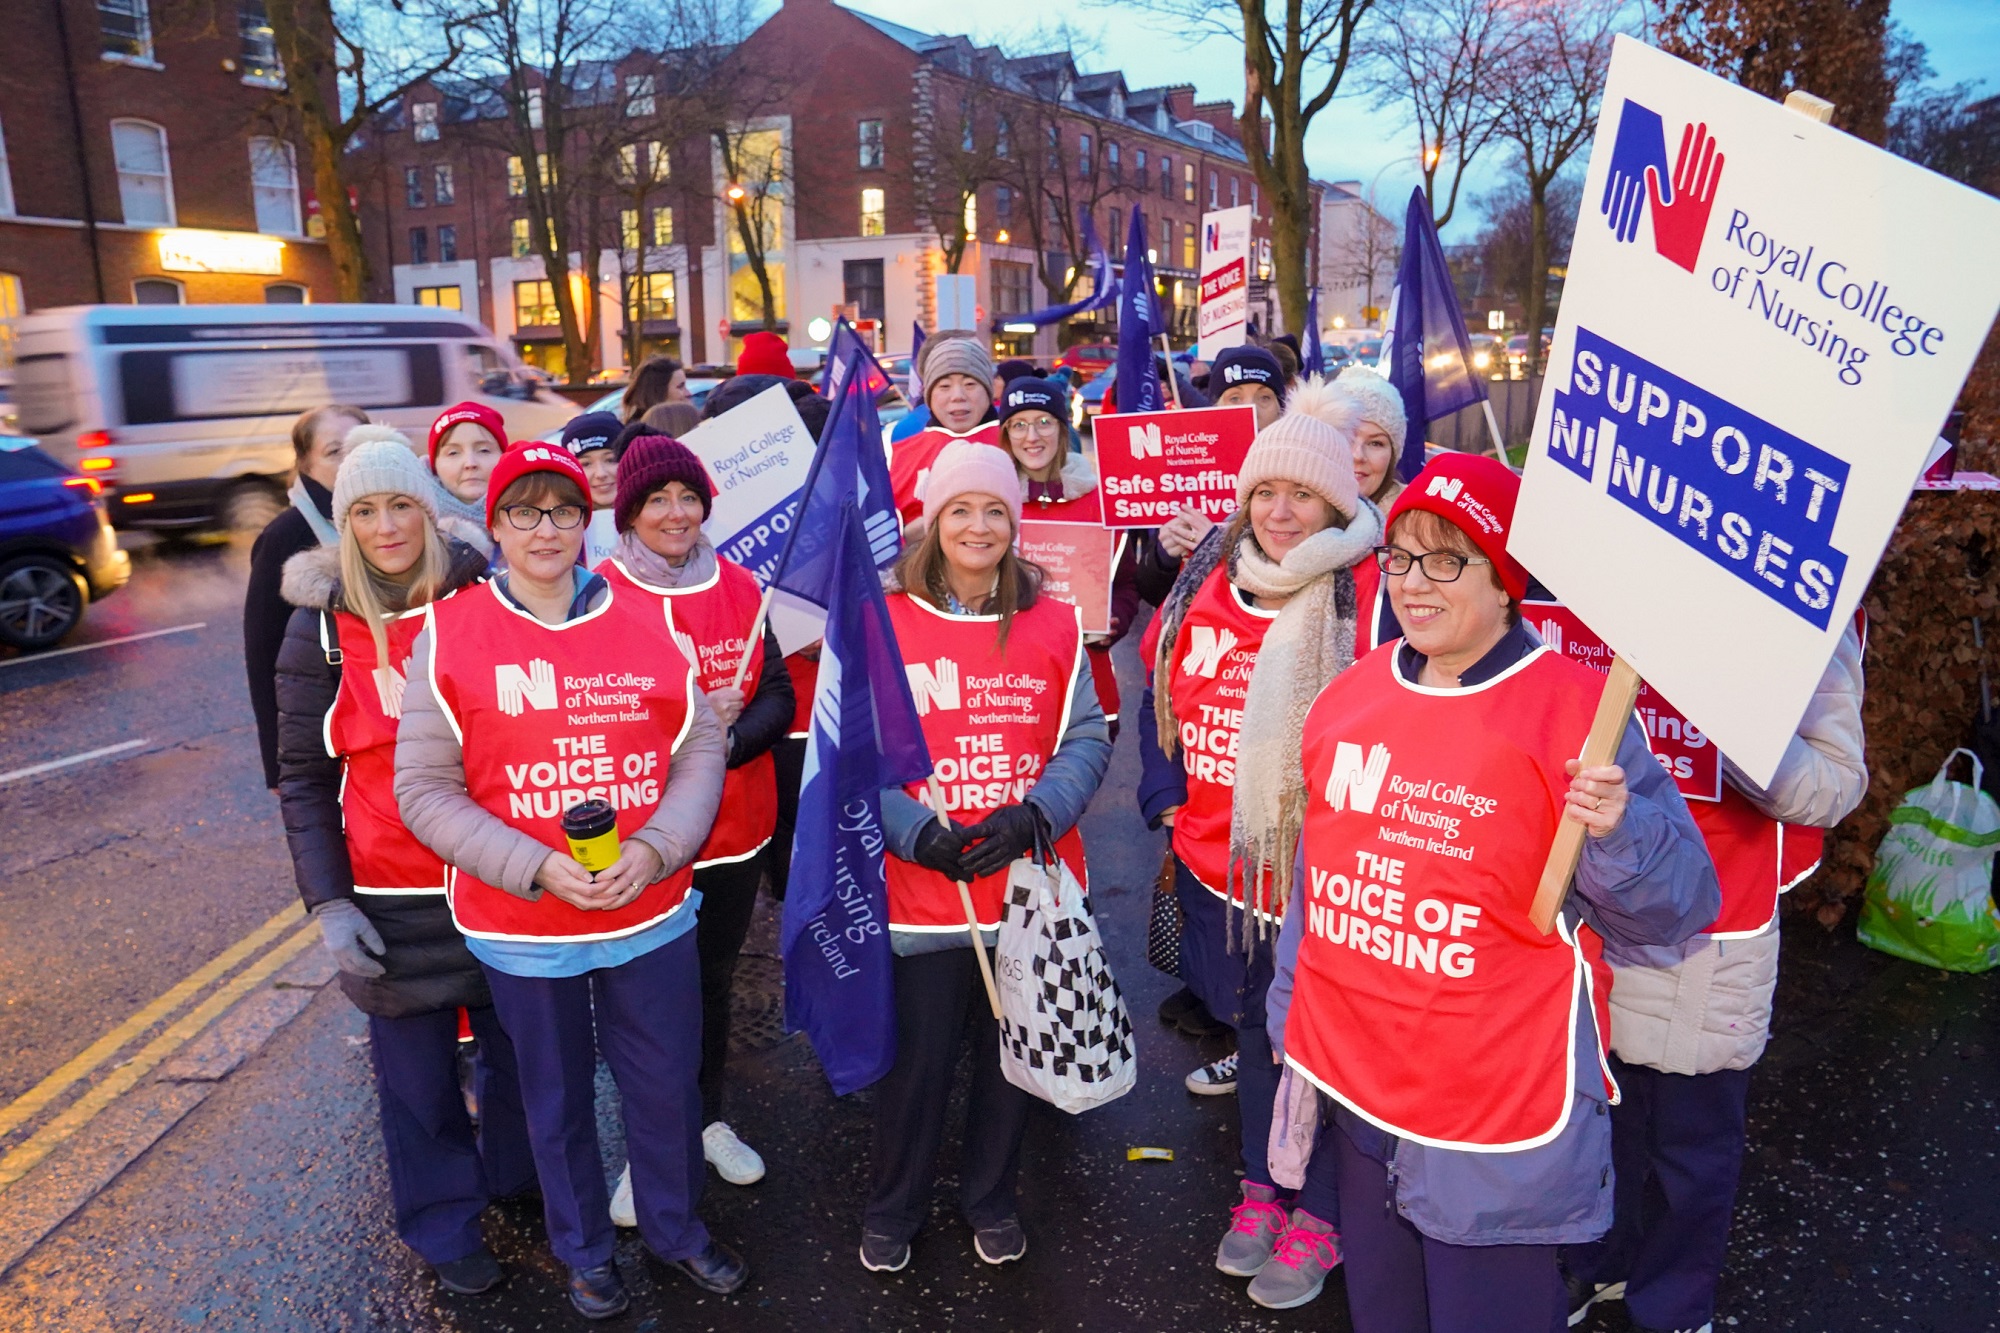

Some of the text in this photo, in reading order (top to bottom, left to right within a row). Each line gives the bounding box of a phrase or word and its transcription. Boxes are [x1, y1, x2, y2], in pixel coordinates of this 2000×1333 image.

[1725, 209, 1945, 357] Royal College
[1712, 264, 1870, 386] of Nursing
[1164, 432, 1219, 447] Royal College
[1573, 349, 1841, 523] SUPPORT
[714, 424, 795, 475] Royal College
[1165, 446, 1208, 457] of Nursing
[724, 450, 789, 490] of Nursing
[1105, 470, 1239, 495] Safe Staffin
[1115, 500, 1181, 518] Saves
[1462, 492, 1485, 512] Royal
[1549, 408, 1835, 611] NI NURSES
[1227, 648, 1257, 665] Roya
[1569, 641, 1604, 659] Royal
[564, 673, 656, 693] Royal College
[966, 673, 1047, 694] Royal College
[1222, 666, 1237, 681] of
[565, 691, 641, 710] of Nursing
[967, 693, 1033, 712] of Nursing
[568, 708, 649, 726] Northern Ireland
[969, 713, 1012, 725] Northern
[1199, 704, 1244, 729] THE
[553, 735, 606, 757] THE
[954, 733, 1004, 754] THE
[1179, 719, 1241, 758] OICE
[505, 751, 657, 790] VOICE OF
[931, 754, 1012, 783] OICE
[1388, 775, 1497, 817] Royal College
[1380, 801, 1461, 839] of Nursing
[1378, 826, 1475, 861] Northern Ireland
[1355, 850, 1406, 885] THE
[1310, 866, 1481, 937] VOICE OF
[808, 913, 860, 980] Ireland
[1309, 901, 1476, 979] NURSING
